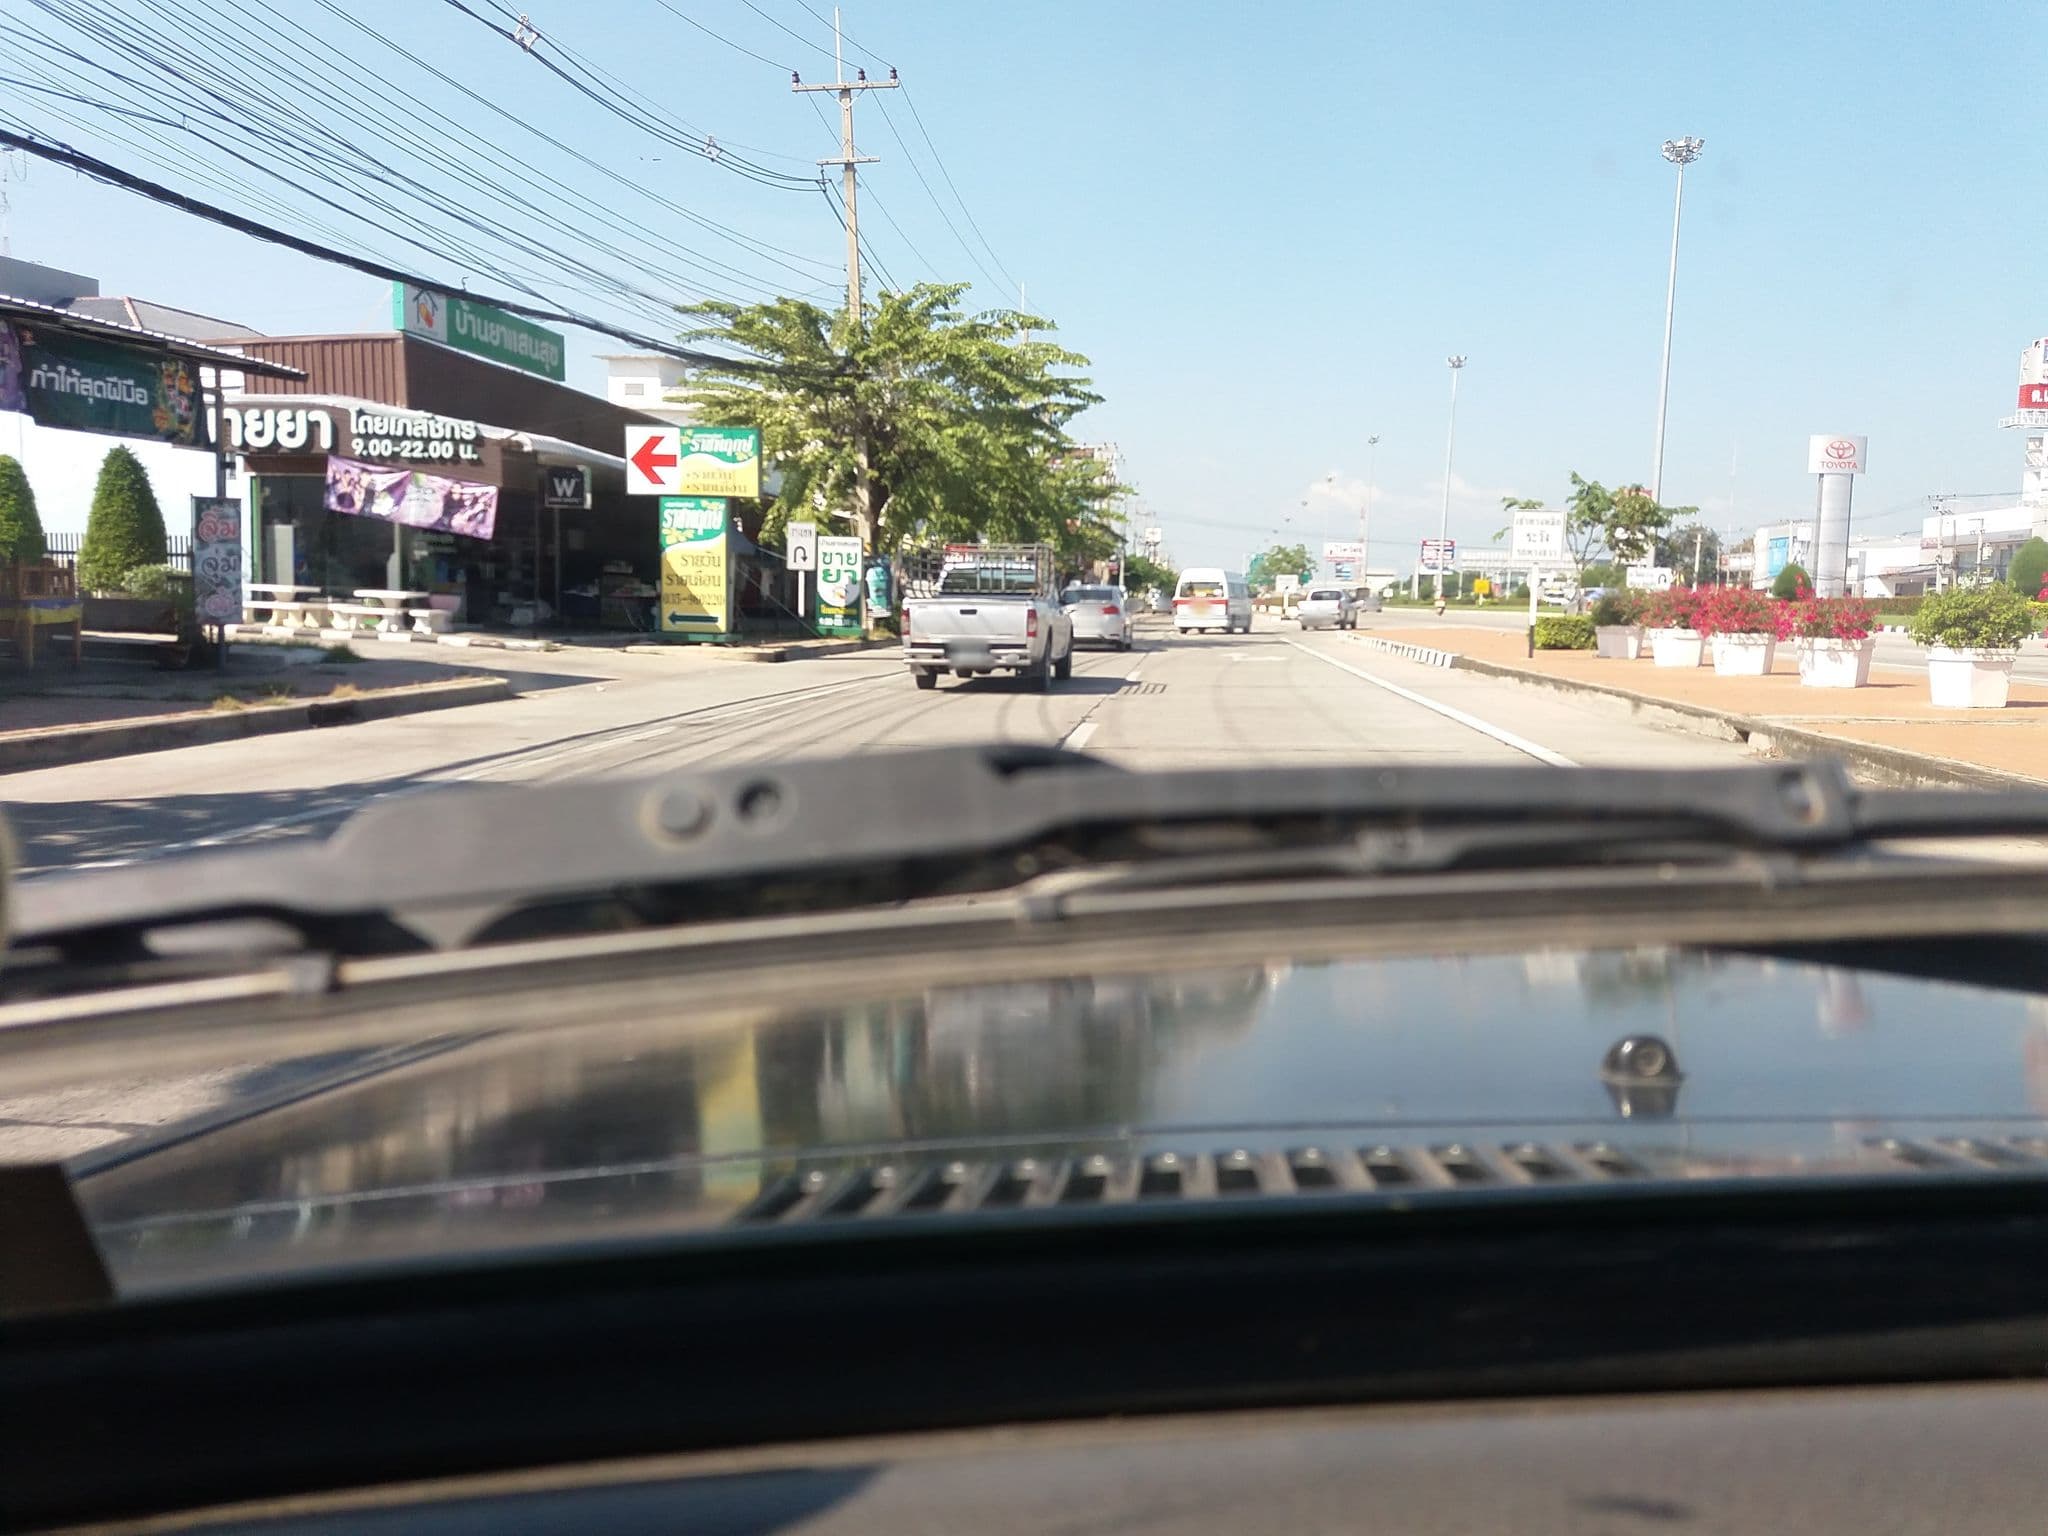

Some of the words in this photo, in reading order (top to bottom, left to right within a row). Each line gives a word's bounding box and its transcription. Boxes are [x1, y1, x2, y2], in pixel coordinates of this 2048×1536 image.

[455, 300, 560, 373] บ้านยาแสนสุข
[351, 438, 454, 458] 9.00-22.00
[459, 444, 478, 459] น.
[1820, 460, 1857, 469] TOYOTA
[822, 551, 858, 566] ขาย
[822, 568, 858, 585] ยา
